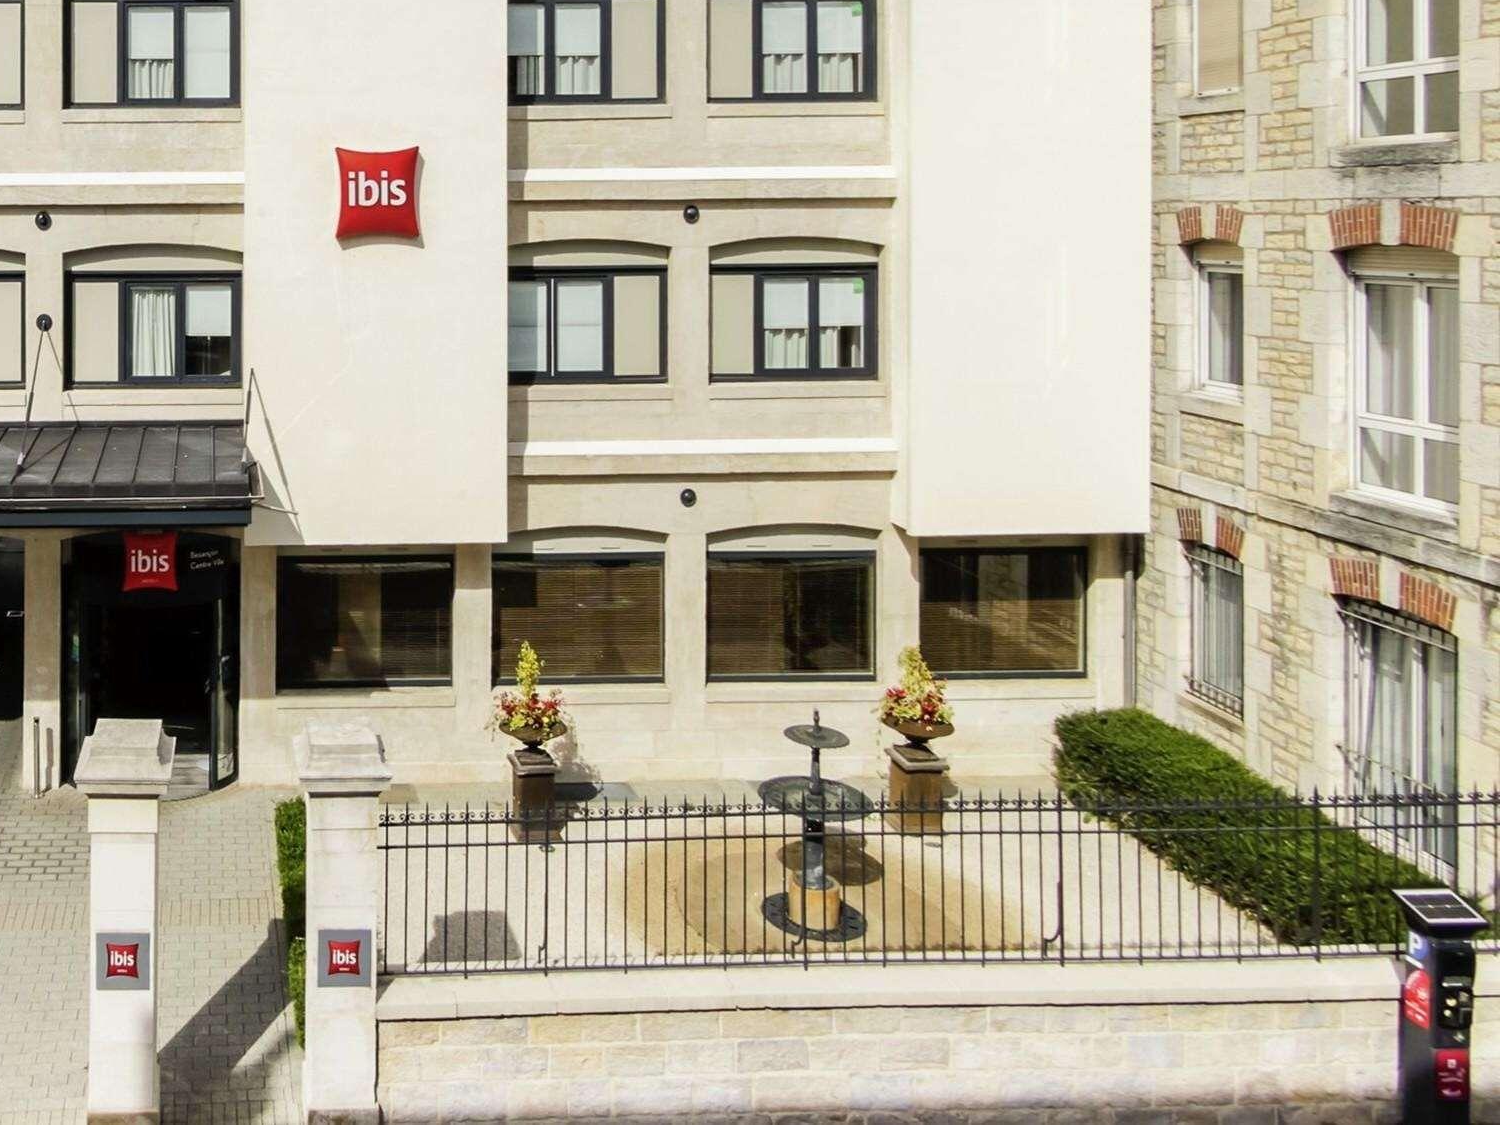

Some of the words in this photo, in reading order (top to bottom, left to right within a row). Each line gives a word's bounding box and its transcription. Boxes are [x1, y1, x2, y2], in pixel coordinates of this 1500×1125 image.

[347, 170, 407, 207] ibis
[131, 549, 170, 572] ibis
[110, 950, 135, 967] ibis
[332, 949, 357, 965] ibis
